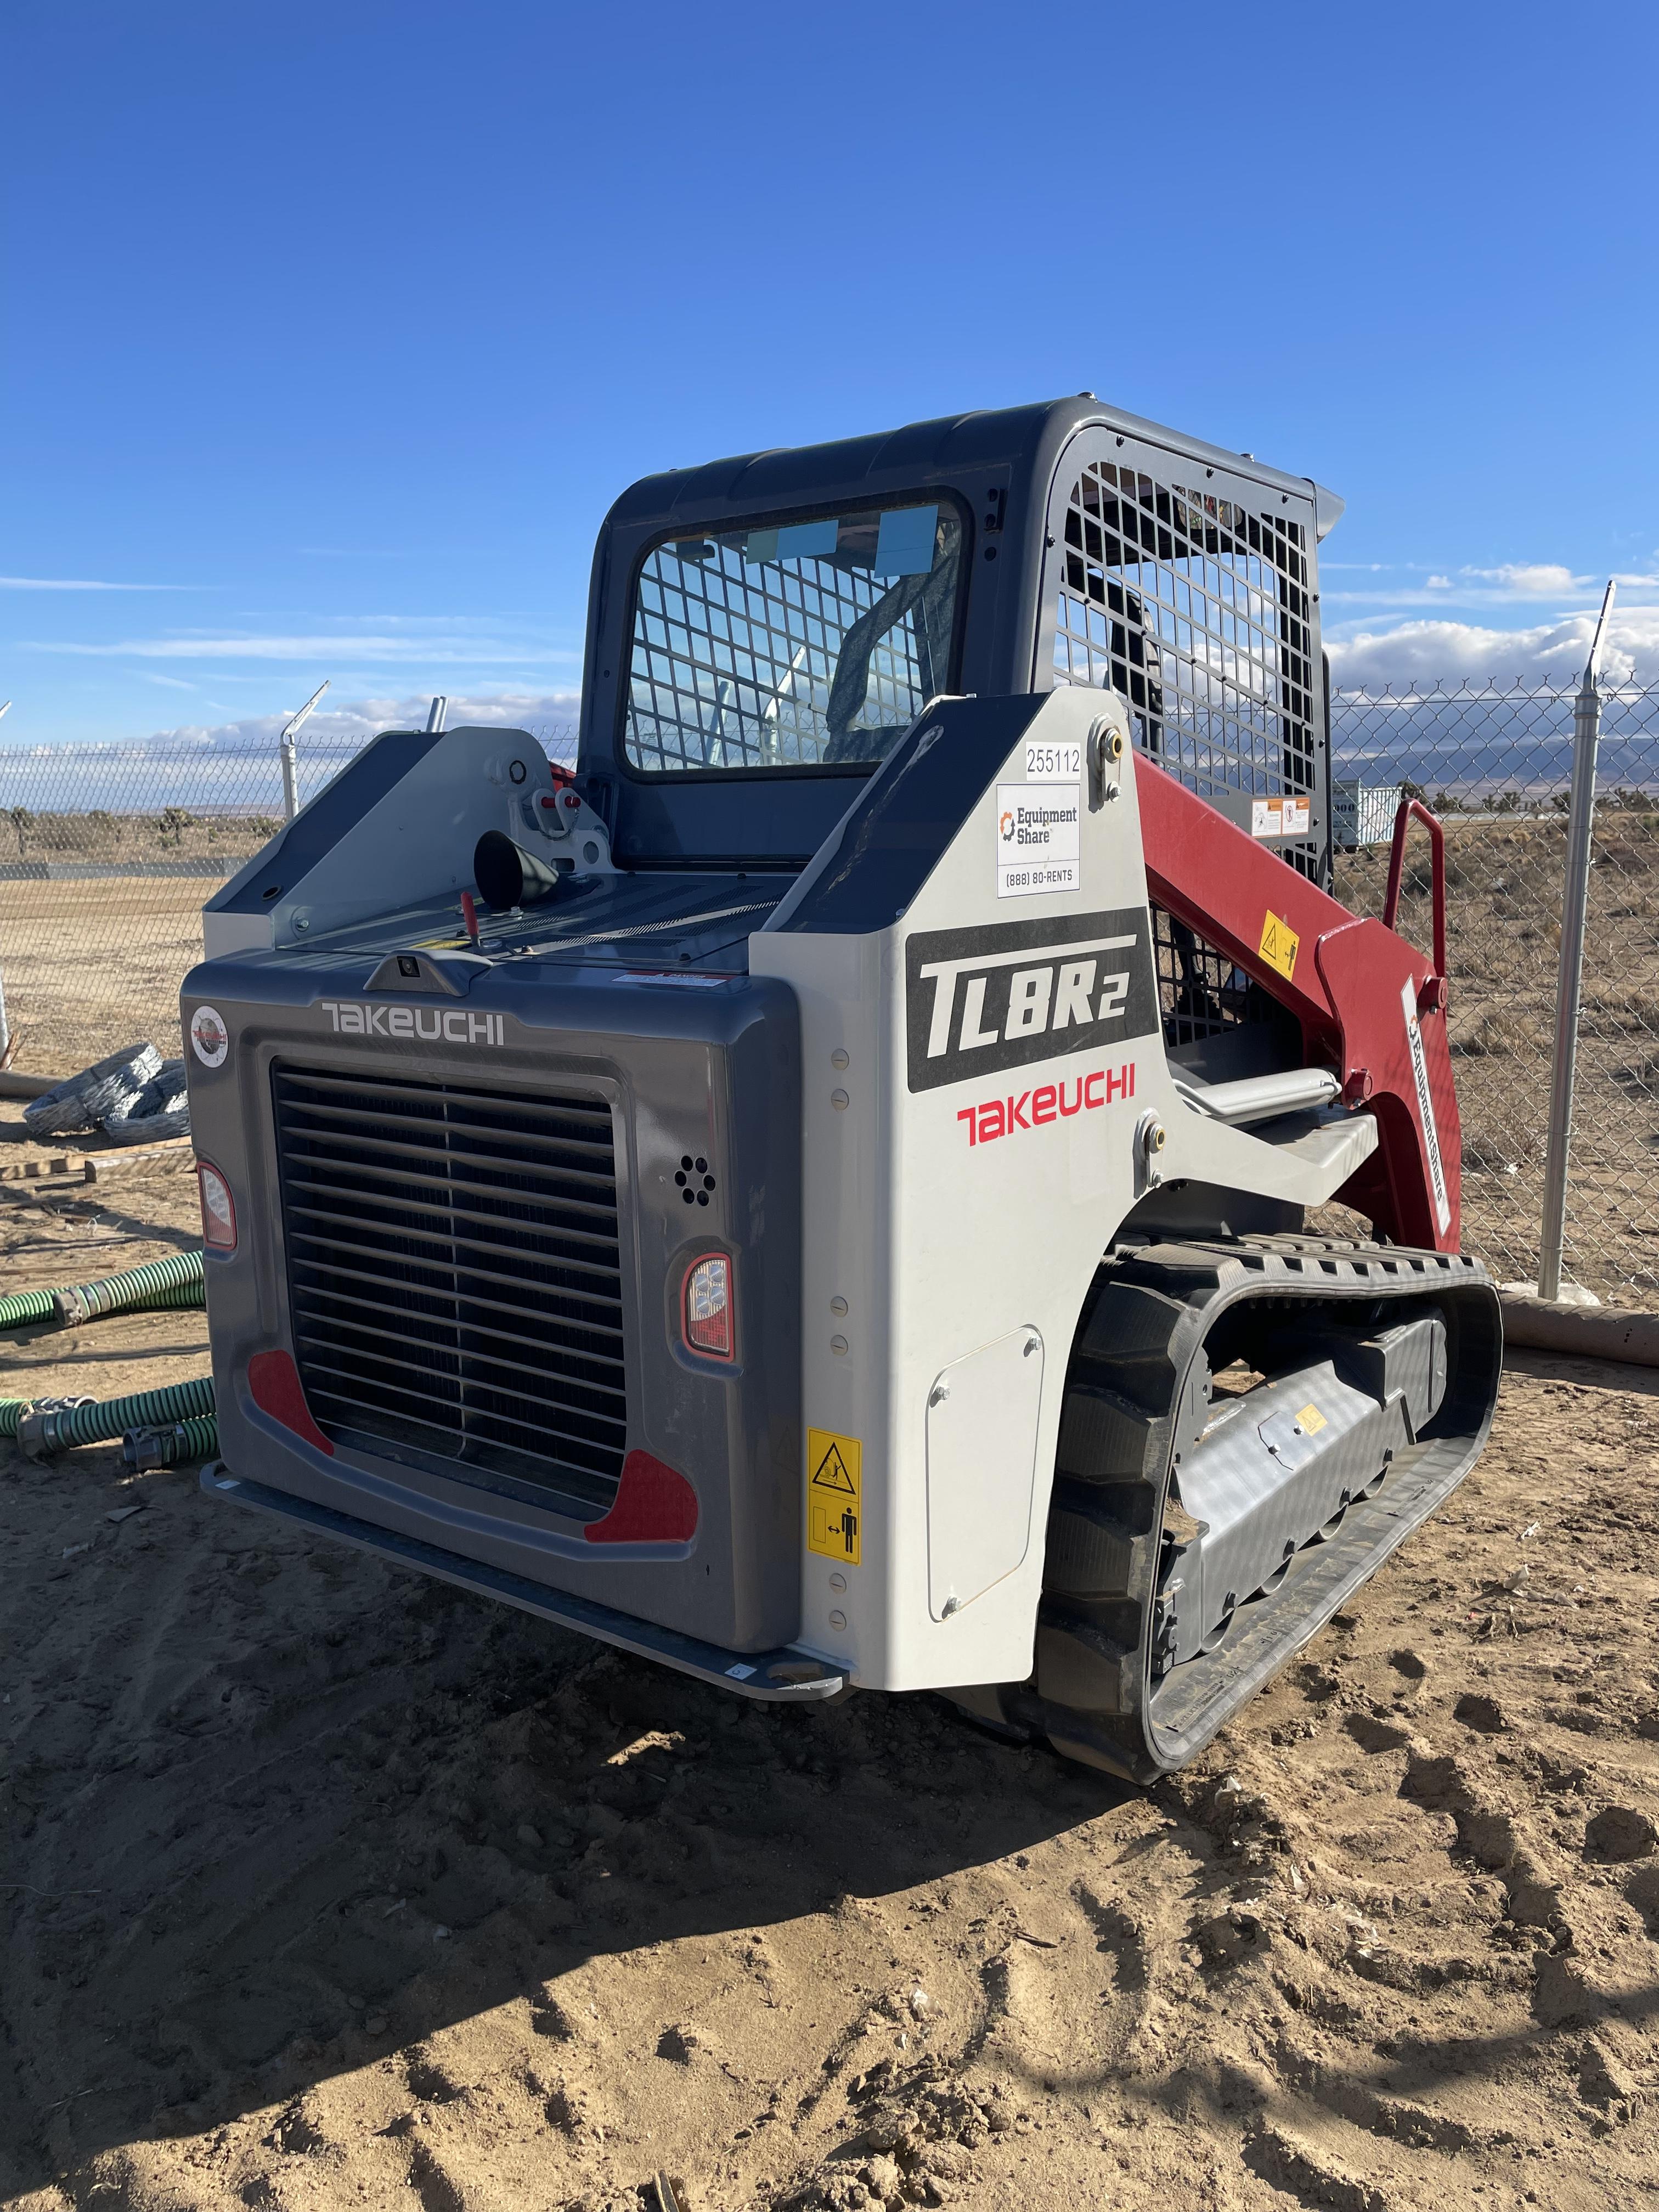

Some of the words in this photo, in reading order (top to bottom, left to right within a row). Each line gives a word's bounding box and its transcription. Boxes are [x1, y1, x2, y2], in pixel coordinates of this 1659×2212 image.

[1028, 749, 1079, 772] 255112
[1017, 807, 1076, 827] Equipment
[1017, 828, 1049, 844] Share
[1007, 872, 1030, 887] (888)
[1032, 870, 1072, 884] 80-RENTS
[1412, 1041, 1443, 1201] EquipmentShare
